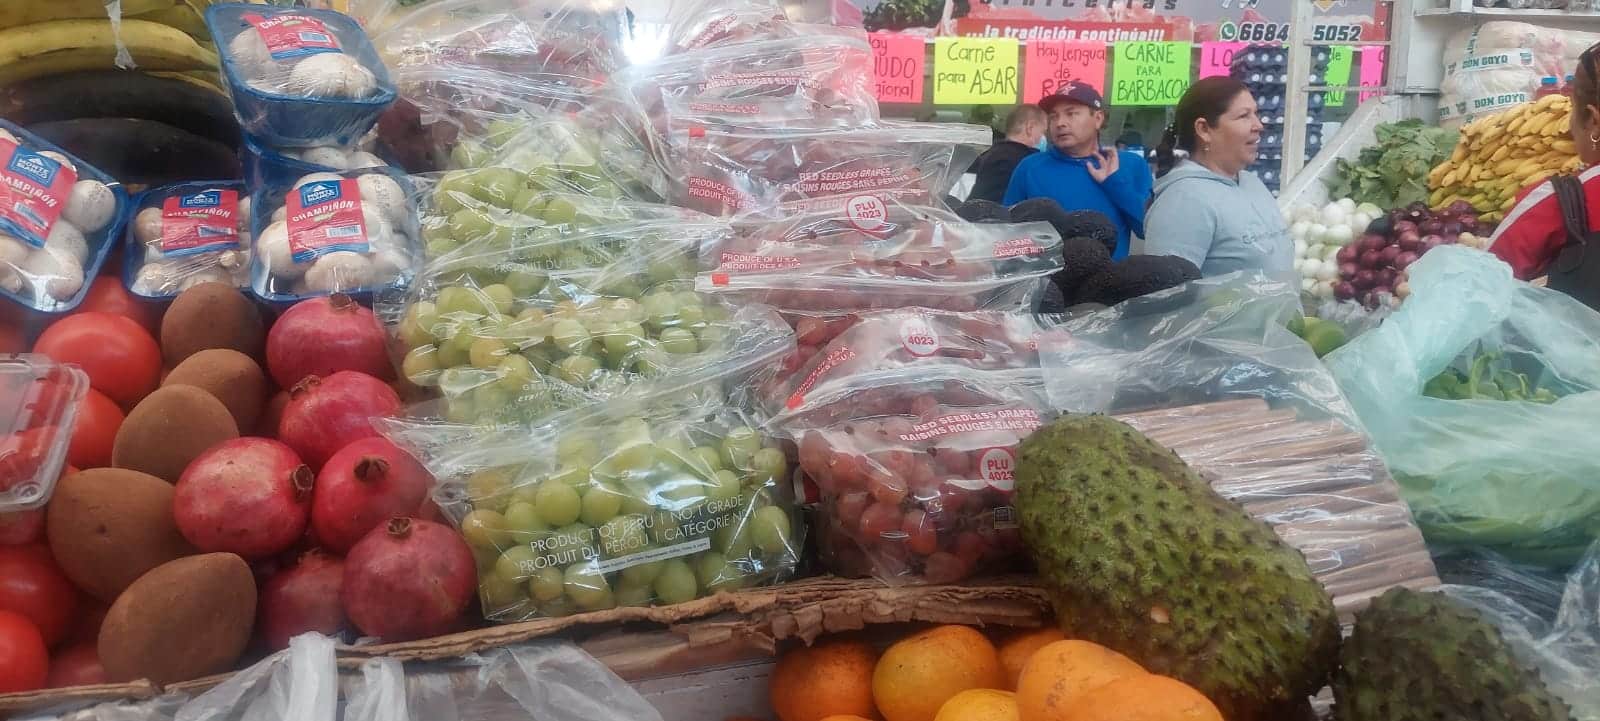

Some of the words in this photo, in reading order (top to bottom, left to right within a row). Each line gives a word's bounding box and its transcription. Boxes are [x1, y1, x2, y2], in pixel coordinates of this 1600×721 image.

[1240, 23, 1290, 41] 6684
[1312, 25, 1362, 41] 5052
[947, 42, 996, 63] Carne
[1036, 41, 1059, 64] Hay
[1125, 43, 1175, 63] CARNE
[1481, 54, 1508, 66] GOYO
[1054, 63, 1071, 79] de
[1136, 65, 1161, 76] PARA
[937, 72, 966, 92] para
[969, 66, 1017, 95] ASAR
[1474, 97, 1495, 108] DON
[1497, 93, 1525, 104] GOYO
[820, 170, 860, 181] SEEDLESS
[860, 167, 891, 177] GRAPES
[690, 177, 726, 193] PRODUCE
[784, 183, 819, 193] RAISINS
[819, 181, 852, 191] ROUGES
[689, 187, 722, 200] PRODUIT
[855, 201, 876, 211] PLU
[722, 253, 761, 262] PRODUCE
[908, 335, 935, 346] 4023
[913, 421, 937, 431] RED
[939, 411, 997, 424] SEEDLESS
[900, 427, 947, 441] RAISINS
[949, 420, 994, 432] ROUGES
[995, 419, 1024, 430] SANS
[987, 458, 1009, 470] PLU
[530, 528, 595, 552] PRODUCT
[599, 522, 617, 538] OF
[707, 494, 744, 514] GRADE
[520, 549, 577, 573] PRODUIT
[581, 543, 601, 560] DU
[664, 514, 730, 540] CATÉGORIE
